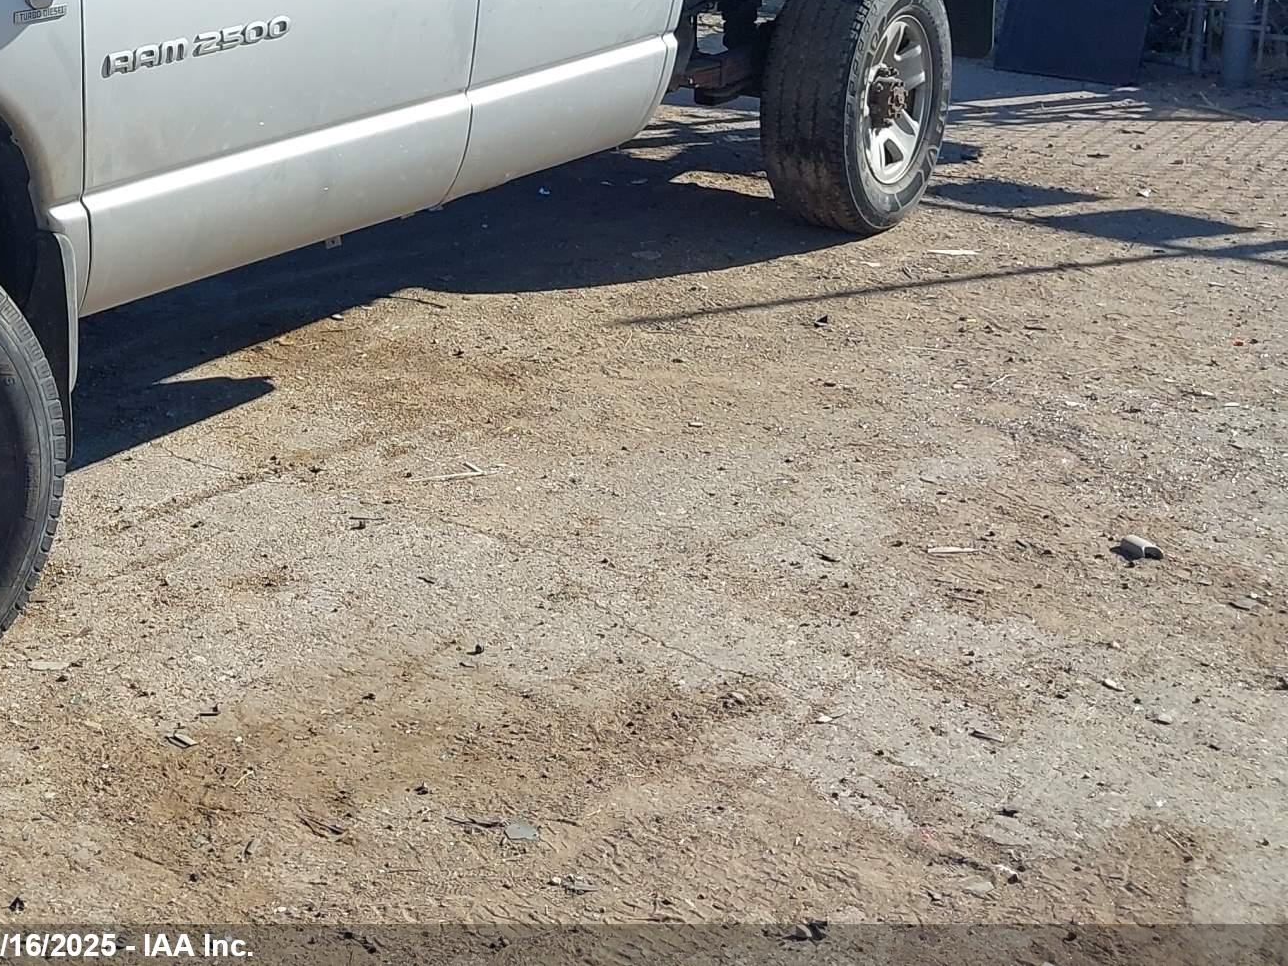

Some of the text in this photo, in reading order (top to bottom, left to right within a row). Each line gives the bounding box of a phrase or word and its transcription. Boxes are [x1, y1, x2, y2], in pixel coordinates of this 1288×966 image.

[20, 10, 42, 21] TURBO
[101, 15, 291, 79] RAM 2500
